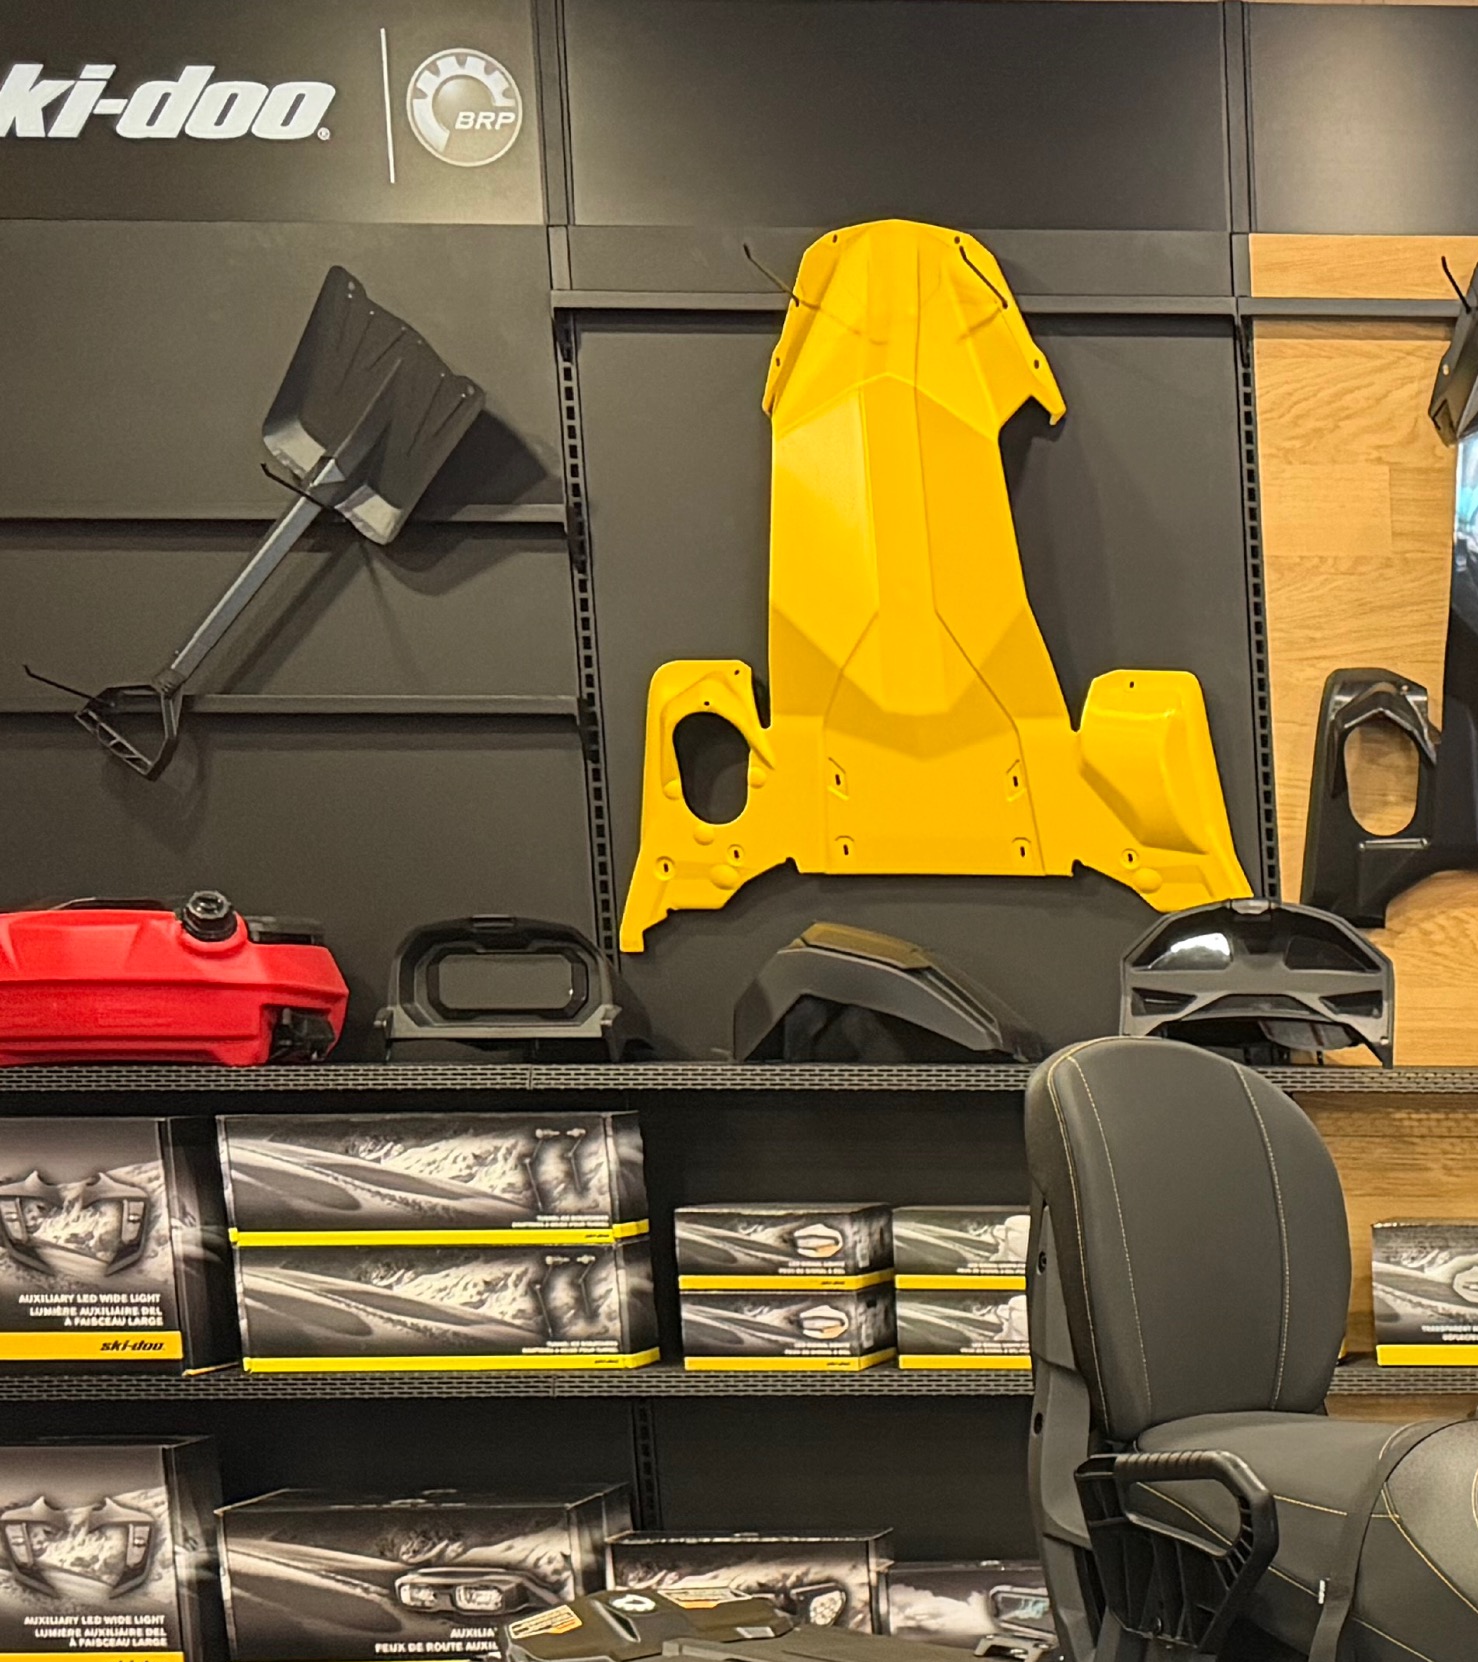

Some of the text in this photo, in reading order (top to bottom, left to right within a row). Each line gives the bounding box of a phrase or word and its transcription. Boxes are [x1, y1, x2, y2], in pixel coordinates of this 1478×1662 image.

[455, 111, 516, 130] BRP
[18, 1293, 161, 1304] AUXILIARY LED WIDE LIGHT
[141, 1306, 163, 1316] DEL
[128, 1317, 164, 1326] LARGE
[23, 1615, 165, 1625] AUXILIARY LED WIDE LIGHT
[145, 1627, 167, 1637] DEL
[132, 1638, 168, 1647] LARGE
[375, 1642, 405, 1653] FEUX
[408, 1642, 423, 1652] DE
[426, 1642, 463, 1652] ROUTE
